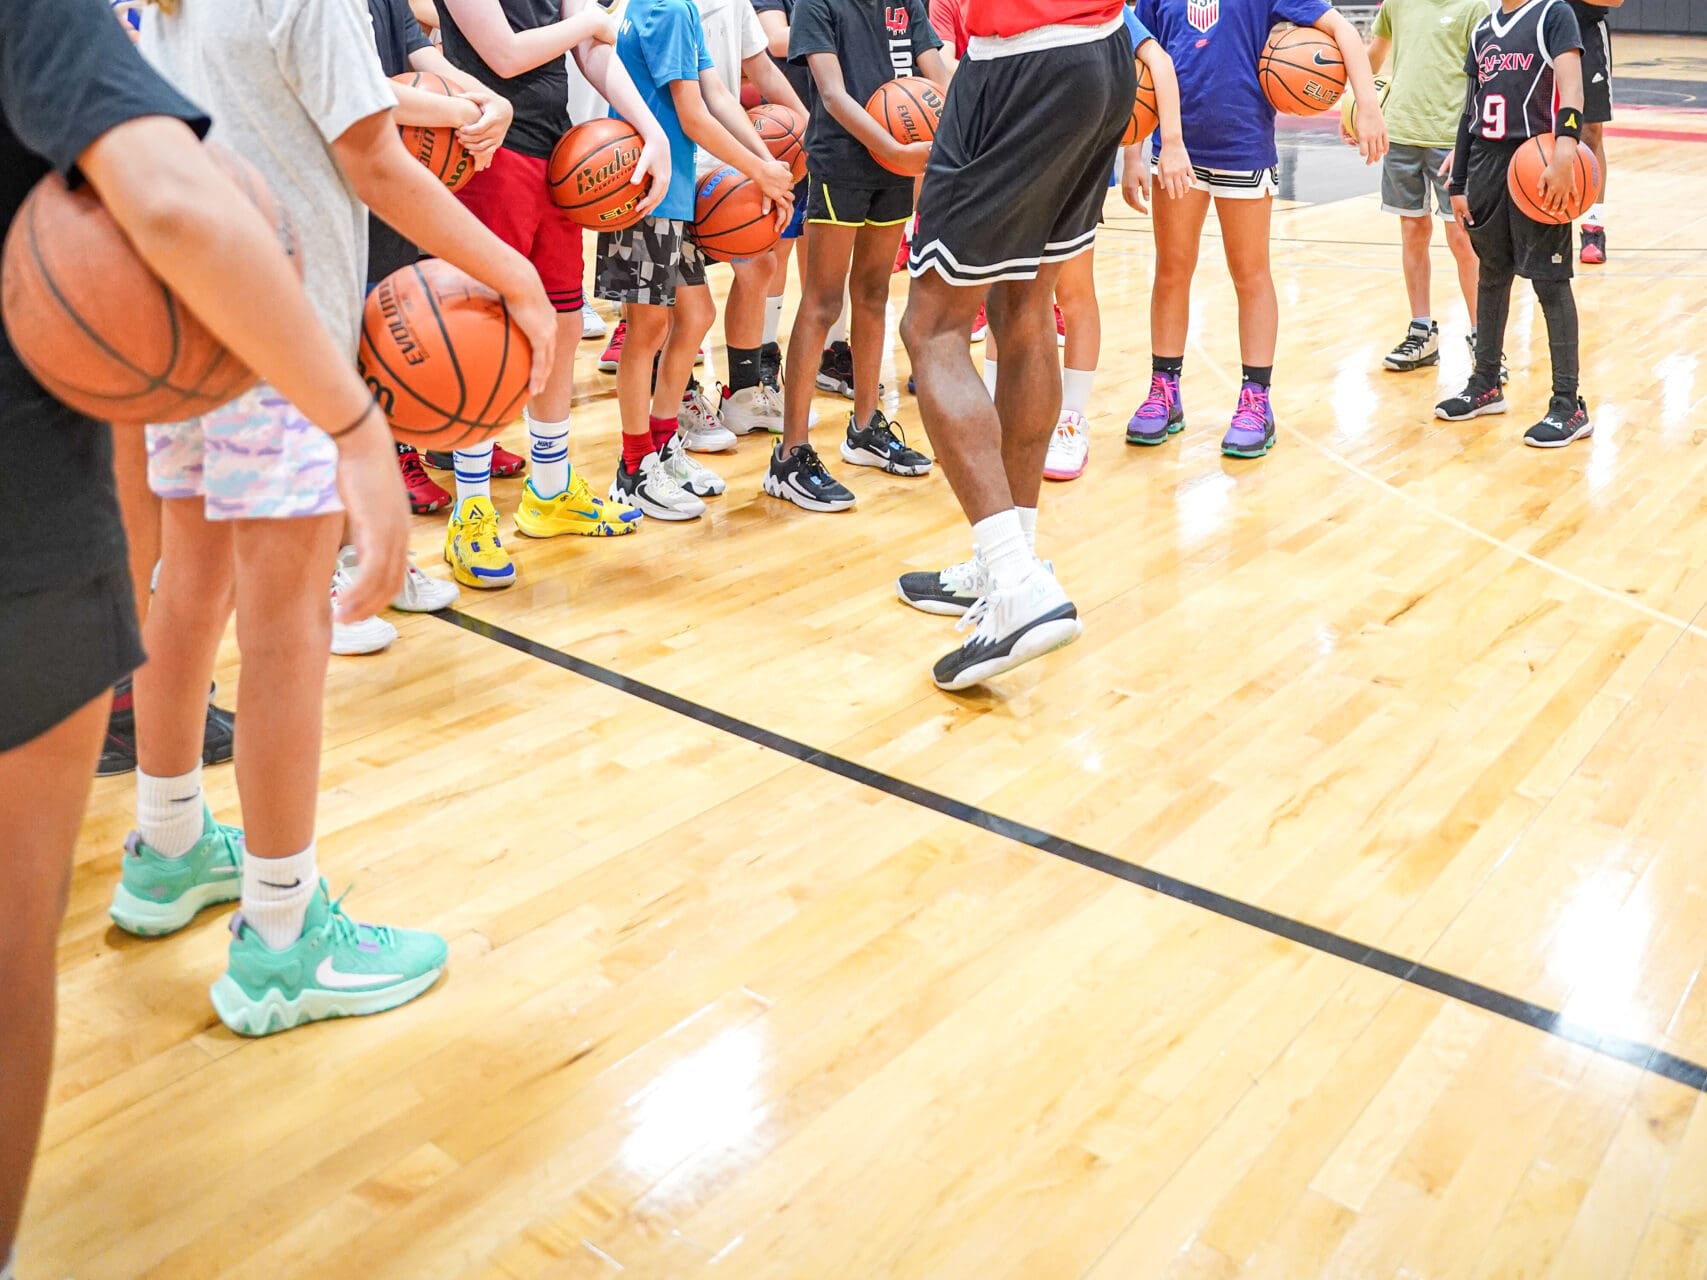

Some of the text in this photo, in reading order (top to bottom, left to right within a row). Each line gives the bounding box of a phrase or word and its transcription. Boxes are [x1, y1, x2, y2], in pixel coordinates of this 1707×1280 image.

[1304, 80, 1339, 102] ELITE
[1481, 93, 1507, 139] 9
[576, 147, 642, 196] Baden
